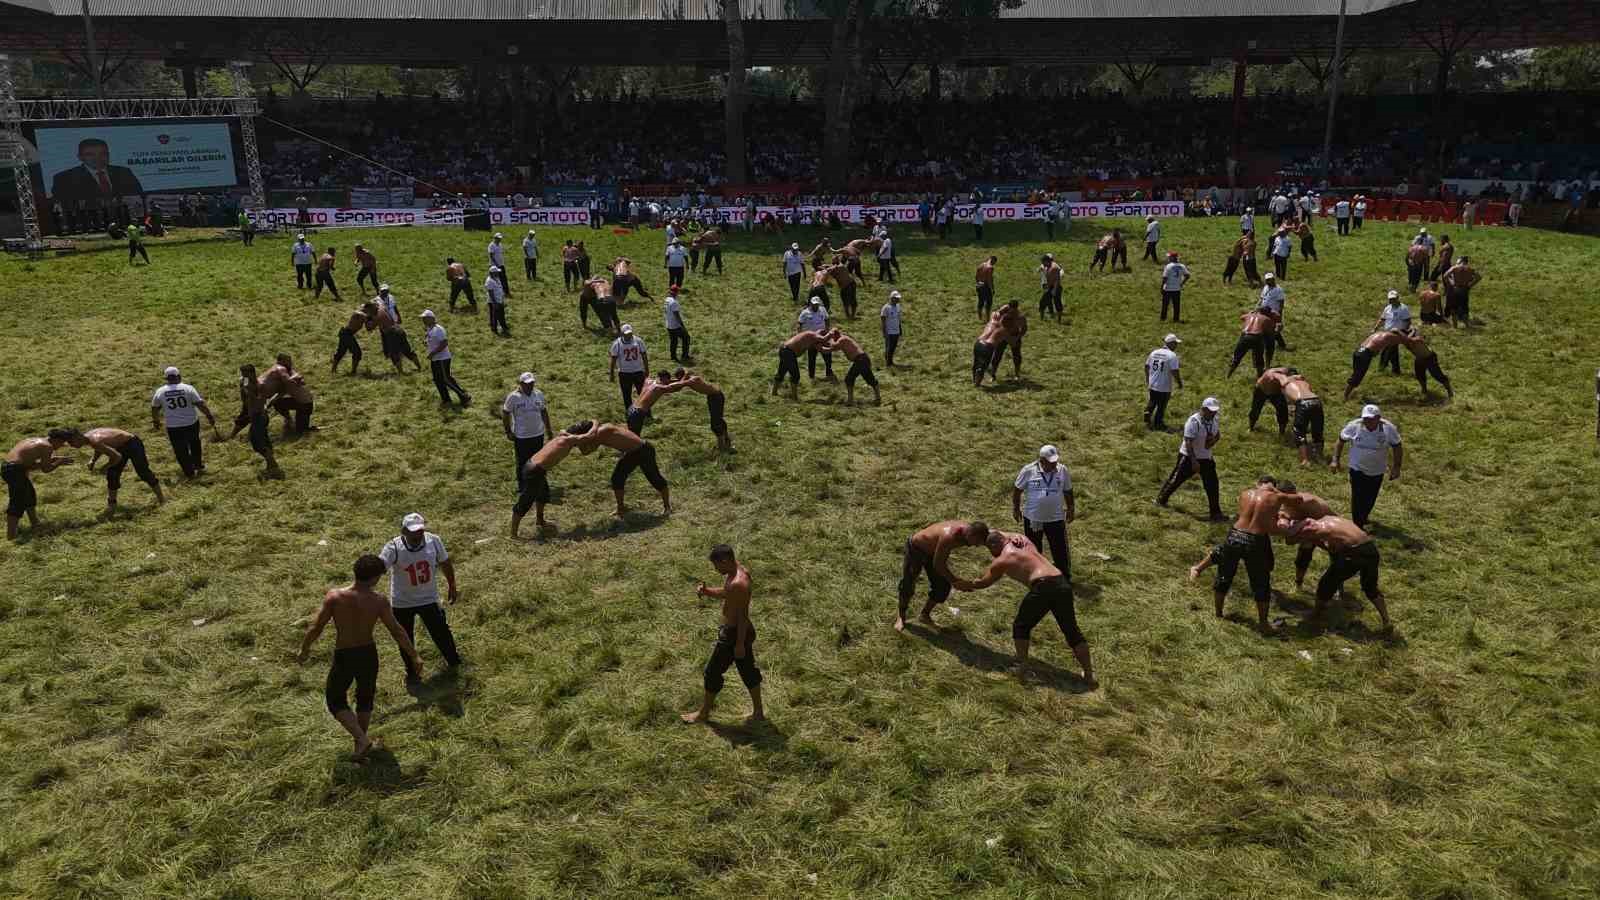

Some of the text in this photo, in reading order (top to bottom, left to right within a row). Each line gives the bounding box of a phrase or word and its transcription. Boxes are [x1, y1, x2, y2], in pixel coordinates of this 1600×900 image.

[247, 211, 588, 224] SORTTO SPORTOTO SPORO SPORTOTO
[775, 209, 850, 221] SPROTO
[859, 208, 934, 220] SPORTO
[951, 207, 1015, 218] POROTO
[1023, 206, 1098, 218] SPOOTO
[1104, 205, 1179, 216] SPORTOTO
[623, 347, 640, 361] 23
[1152, 360, 1165, 372] 51
[166, 396, 187, 410] 30
[402, 560, 432, 586] 13
